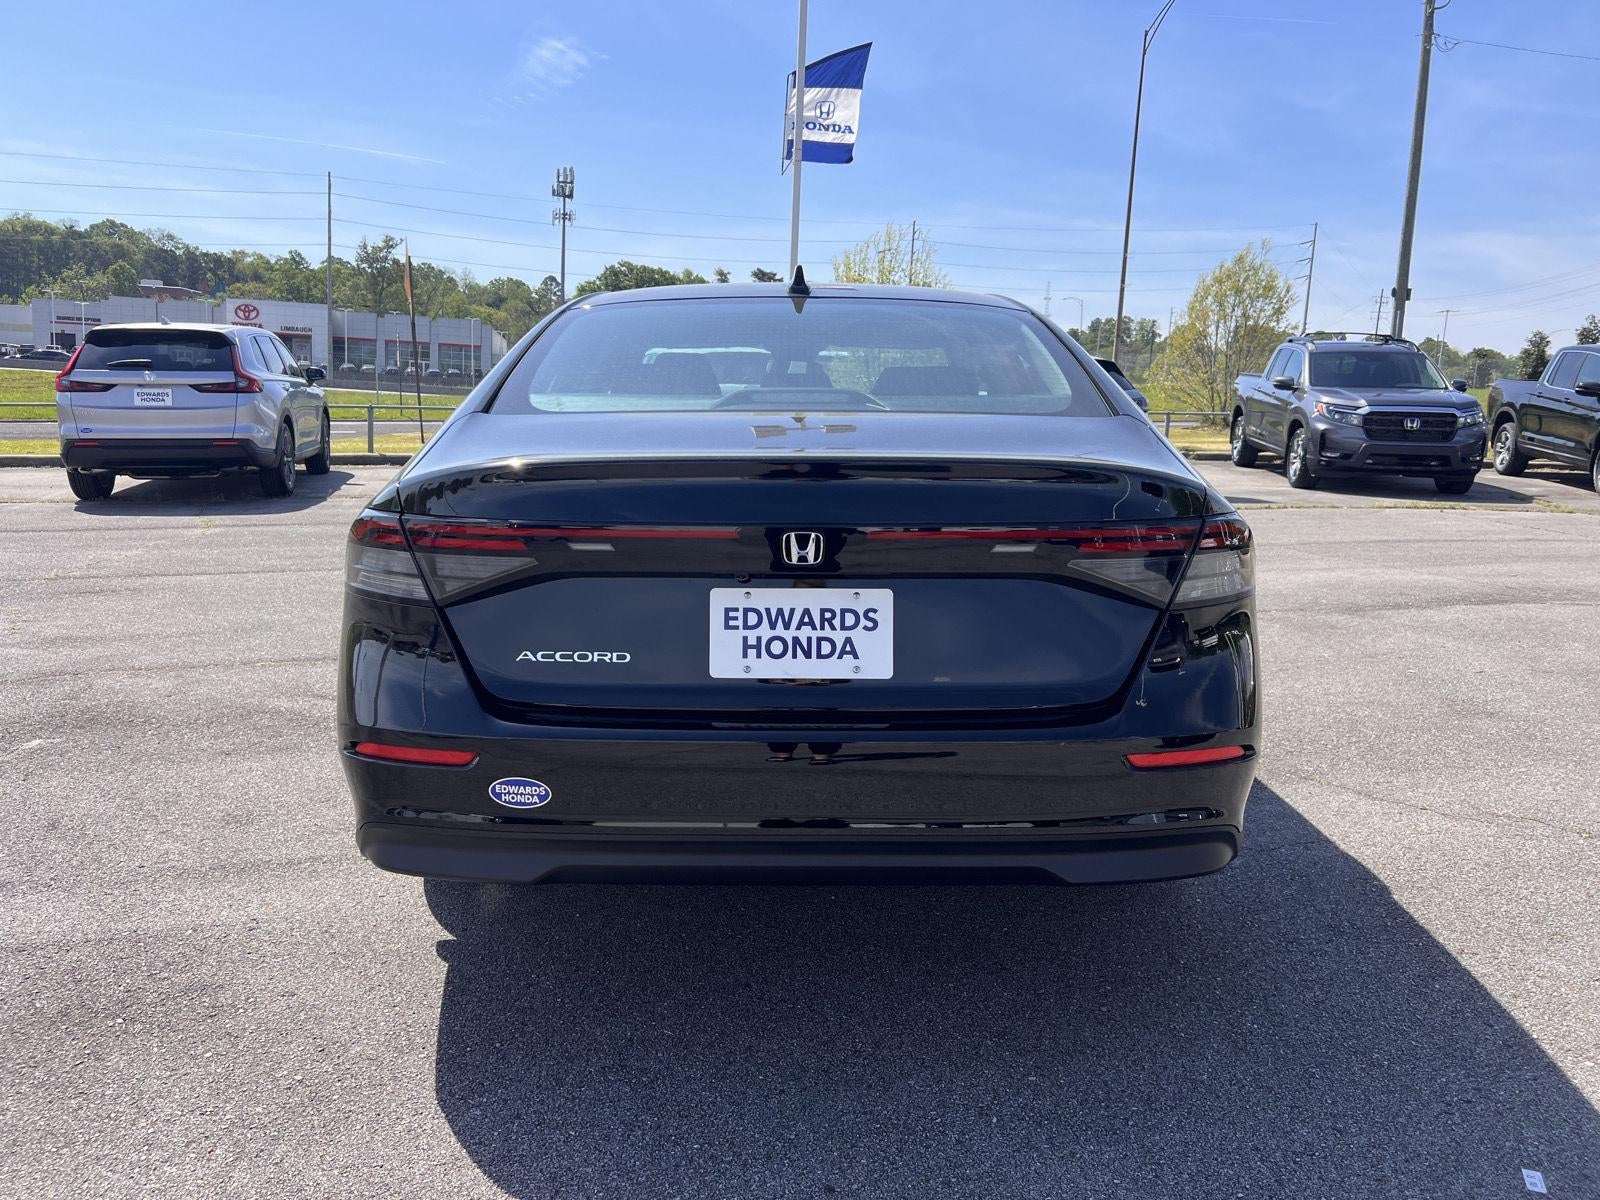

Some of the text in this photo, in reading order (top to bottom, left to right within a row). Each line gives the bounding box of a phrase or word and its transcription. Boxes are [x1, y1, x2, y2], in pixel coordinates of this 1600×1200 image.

[280, 325, 313, 333] LIMBAUGH
[723, 607, 879, 632] EDWARDS
[742, 635, 860, 660] HONDA
[515, 650, 631, 663] ACCORD
[495, 784, 546, 795] EDWARDS
[501, 793, 540, 804] HONDA
